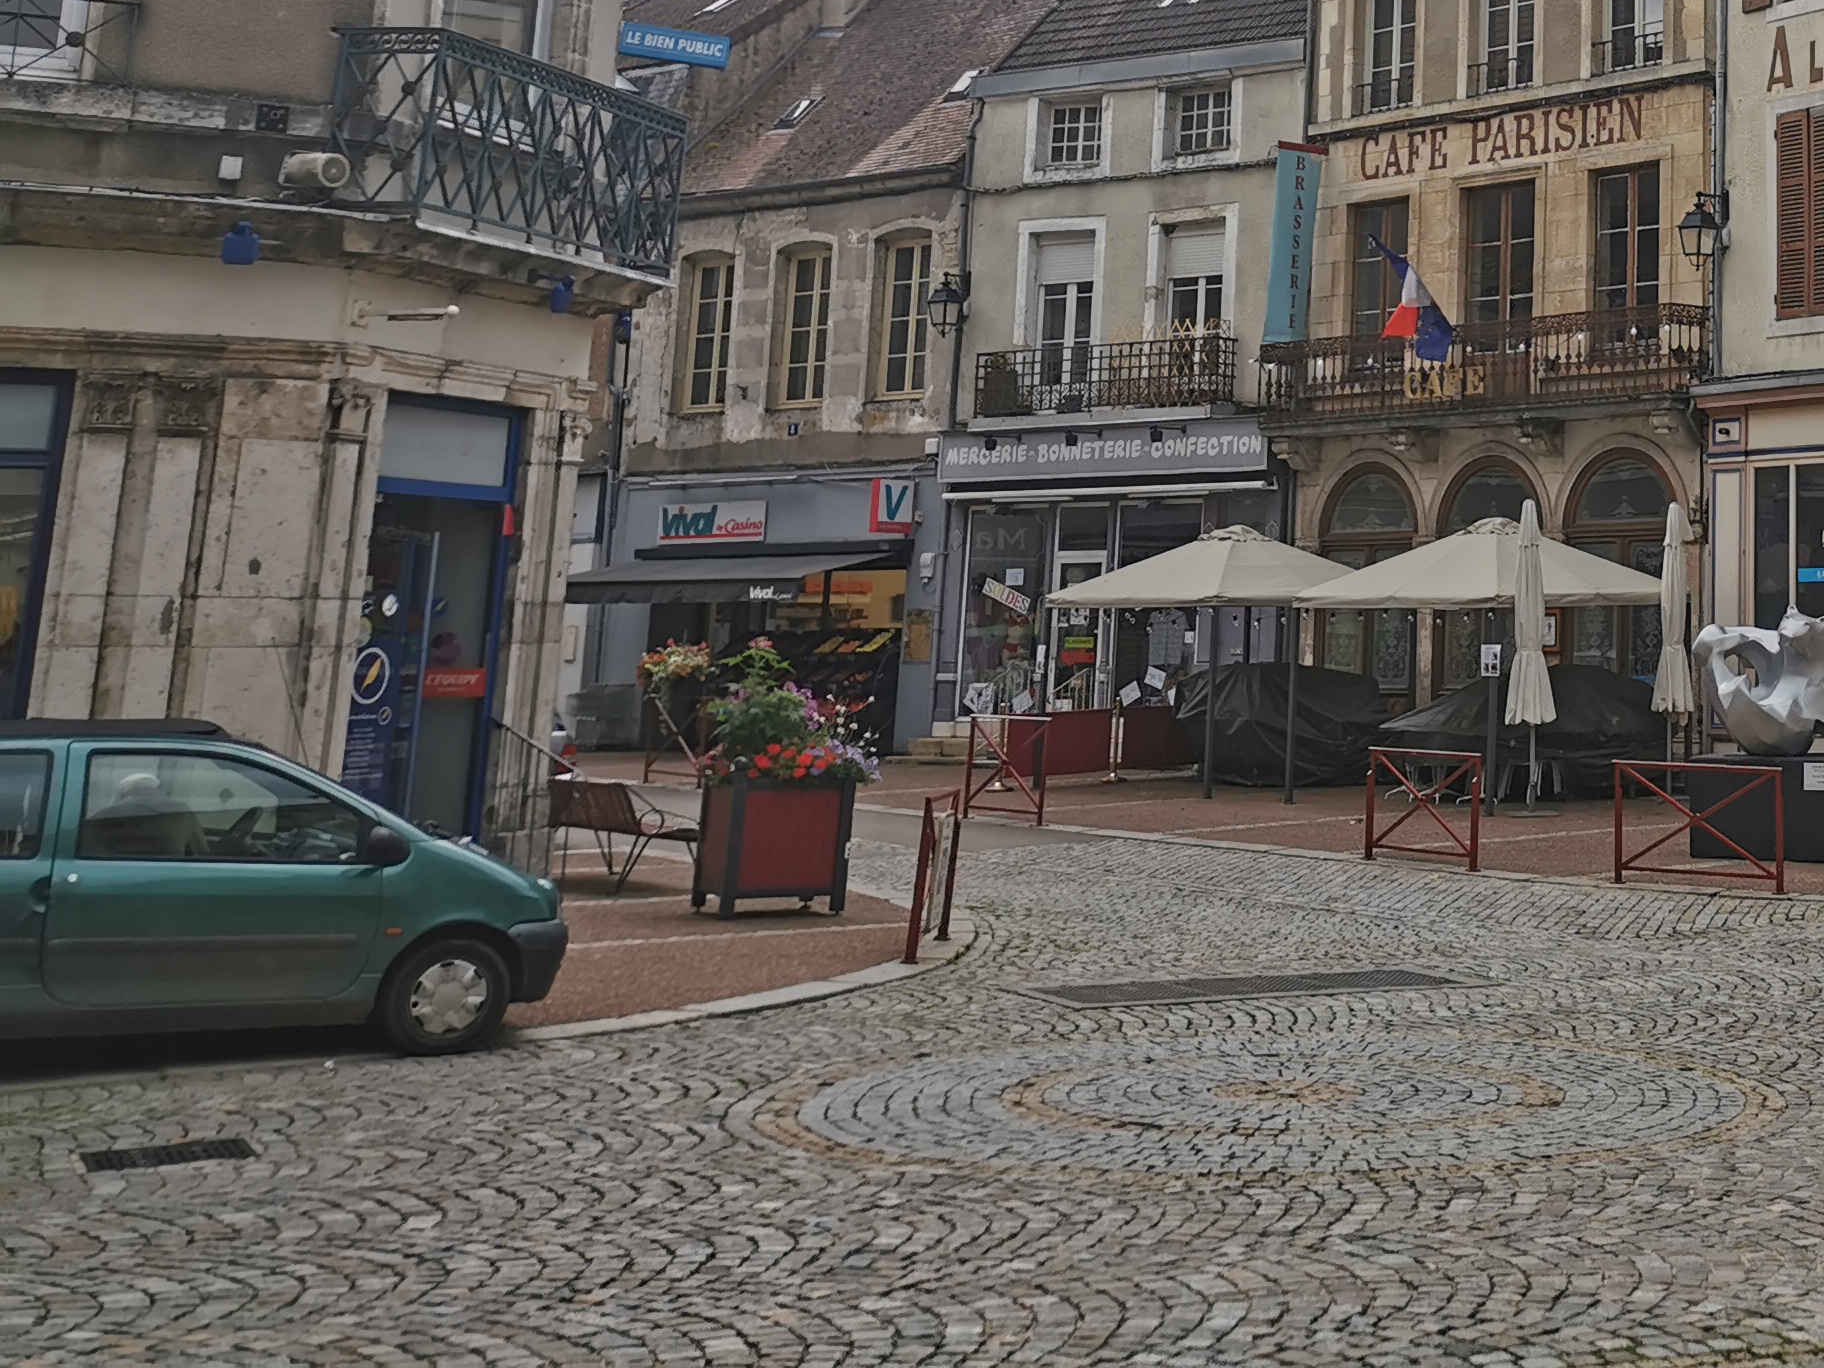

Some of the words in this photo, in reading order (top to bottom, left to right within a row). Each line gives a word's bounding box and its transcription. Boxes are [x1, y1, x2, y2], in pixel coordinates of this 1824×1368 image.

[626, 31, 641, 45] LE
[644, 34, 675, 50] BIEN
[678, 38, 723, 57] PUBLIC
[1767, 25, 1793, 92] A
[1361, 126, 1448, 180] CAFE
[1468, 94, 1645, 165] PARISIEN
[1288, 155, 1306, 330] BRASSERIE
[885, 484, 908, 521] V
[725, 518, 763, 534] Casino
[985, 579, 1029, 612] SOLDES
